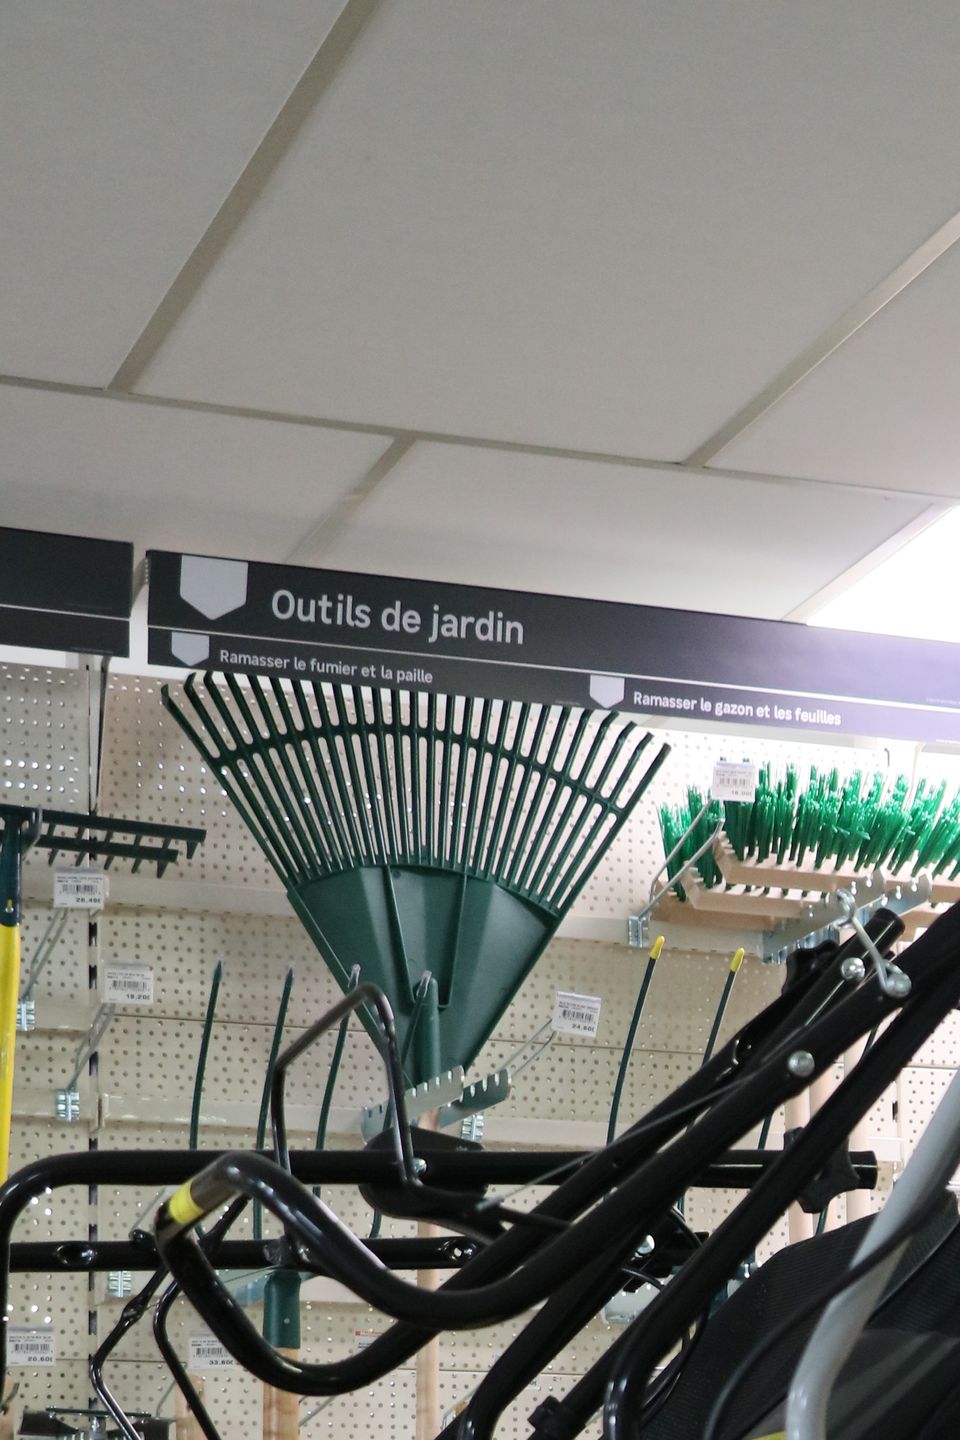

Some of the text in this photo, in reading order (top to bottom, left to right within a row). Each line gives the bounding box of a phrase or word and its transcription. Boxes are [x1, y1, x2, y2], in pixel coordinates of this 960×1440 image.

[271, 589, 524, 645] Outils de jardin
[220, 649, 433, 684] Ramasser le fumier et la paille
[633, 691, 841, 726] Ramasser le gazon et les feuilles
